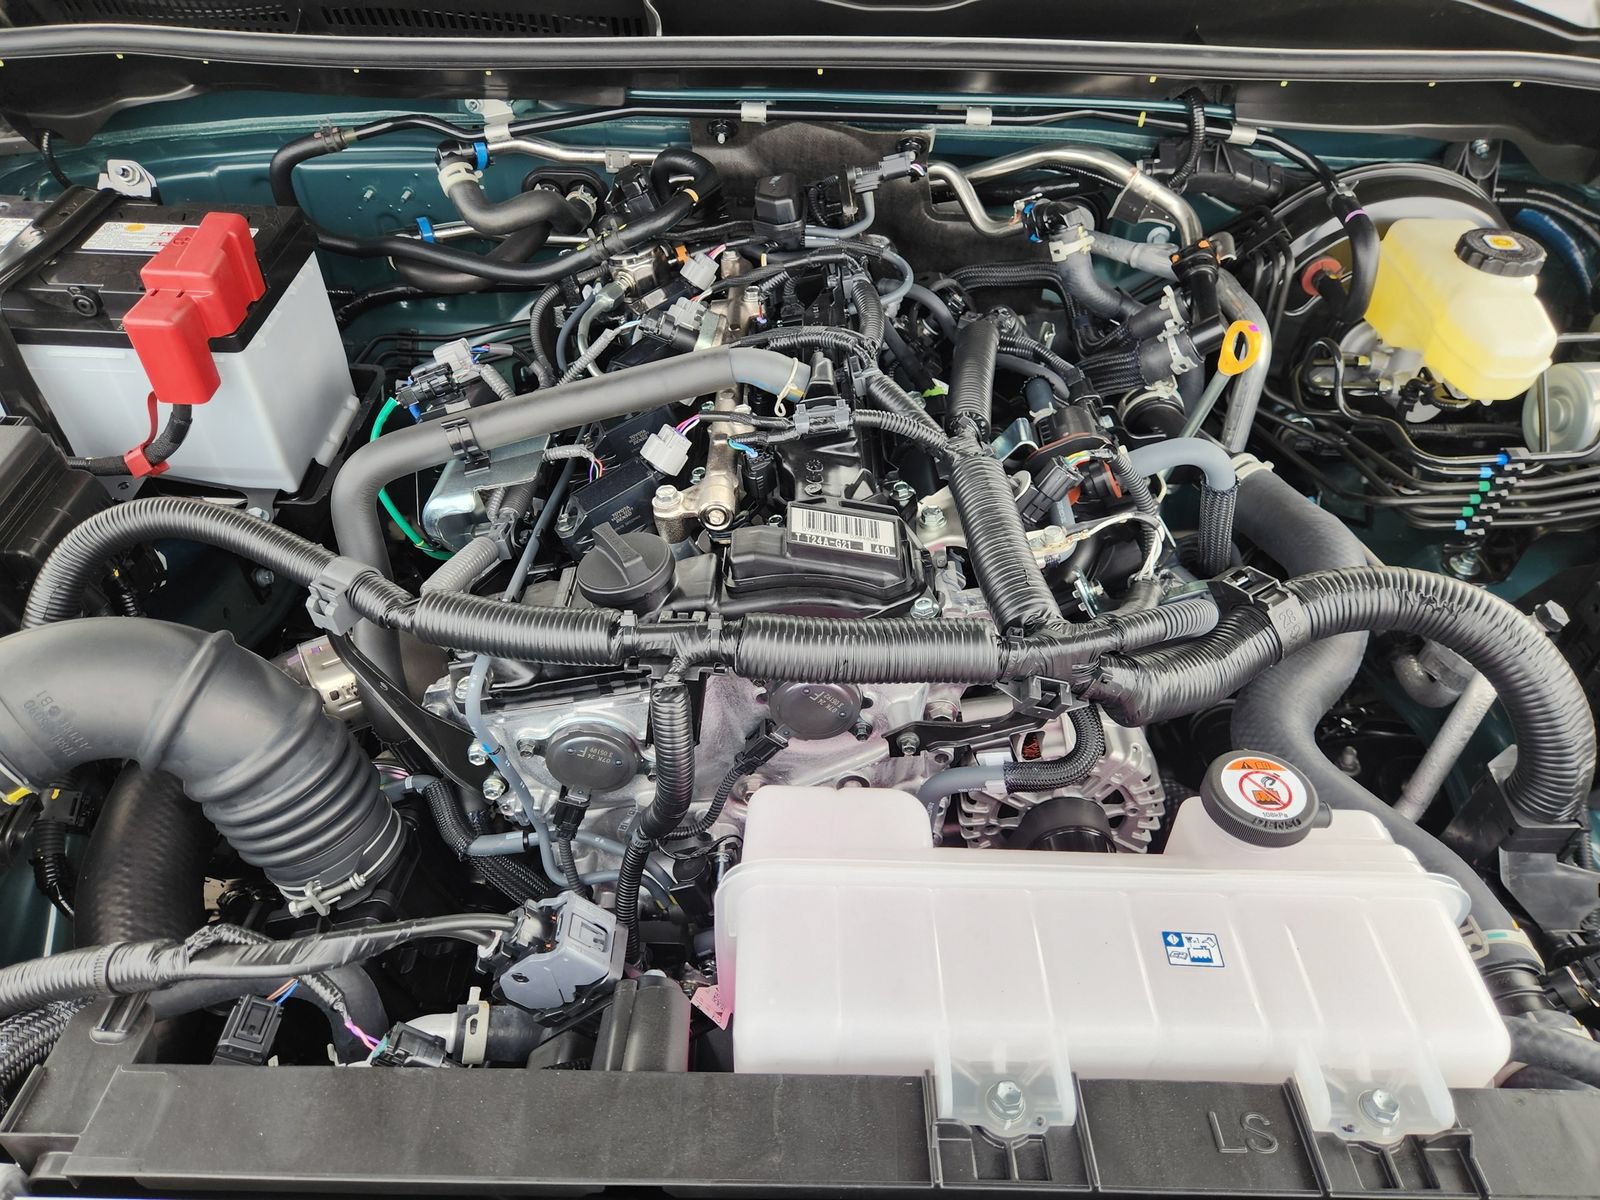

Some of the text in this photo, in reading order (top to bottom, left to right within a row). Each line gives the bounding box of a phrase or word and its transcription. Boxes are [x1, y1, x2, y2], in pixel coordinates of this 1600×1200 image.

[806, 534, 852, 550] T24A-G21
[874, 545, 890, 555] 410
[1252, 816, 1302, 832] DENSO
[1207, 1111, 1280, 1154] LS
